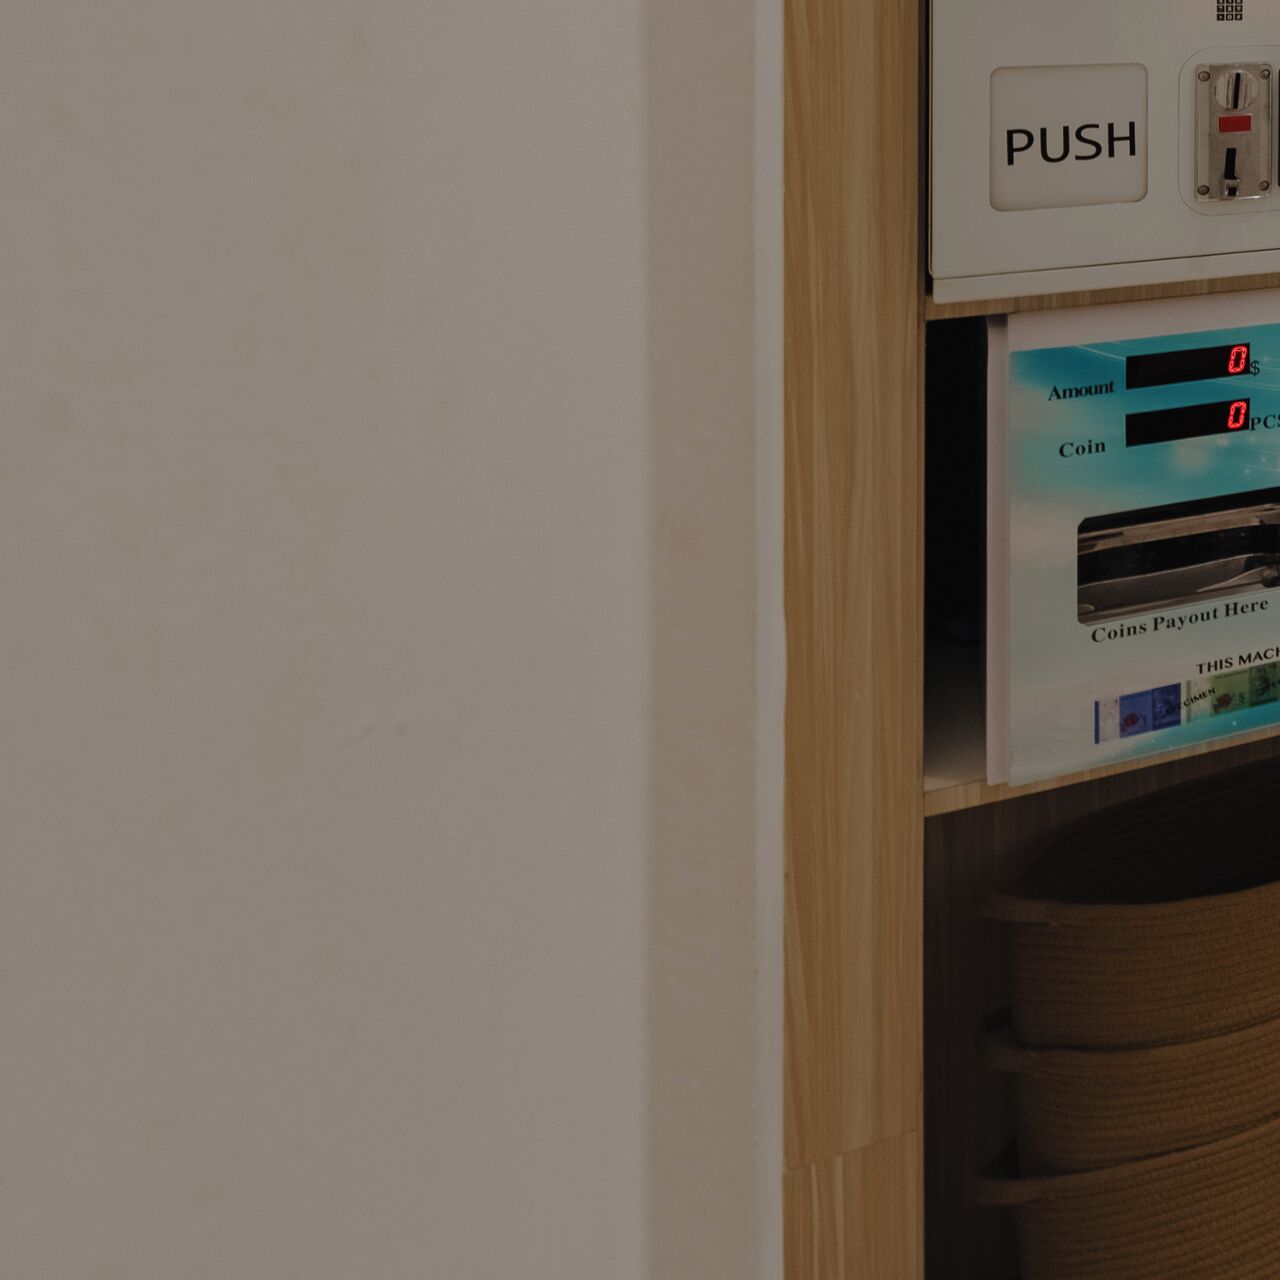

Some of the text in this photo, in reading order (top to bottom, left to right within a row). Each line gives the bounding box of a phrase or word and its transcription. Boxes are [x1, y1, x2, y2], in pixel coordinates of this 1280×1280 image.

[1007, 121, 1136, 166] PUSH
[1228, 344, 1248, 374] 0
[1250, 360, 1260, 376] $
[1048, 380, 1115, 401] Amount
[1227, 400, 1247, 430] 0
[1059, 439, 1105, 458] Coin
[1091, 600, 1269, 643] Coins Payout Here
[1195, 657, 1233, 674] THIS
